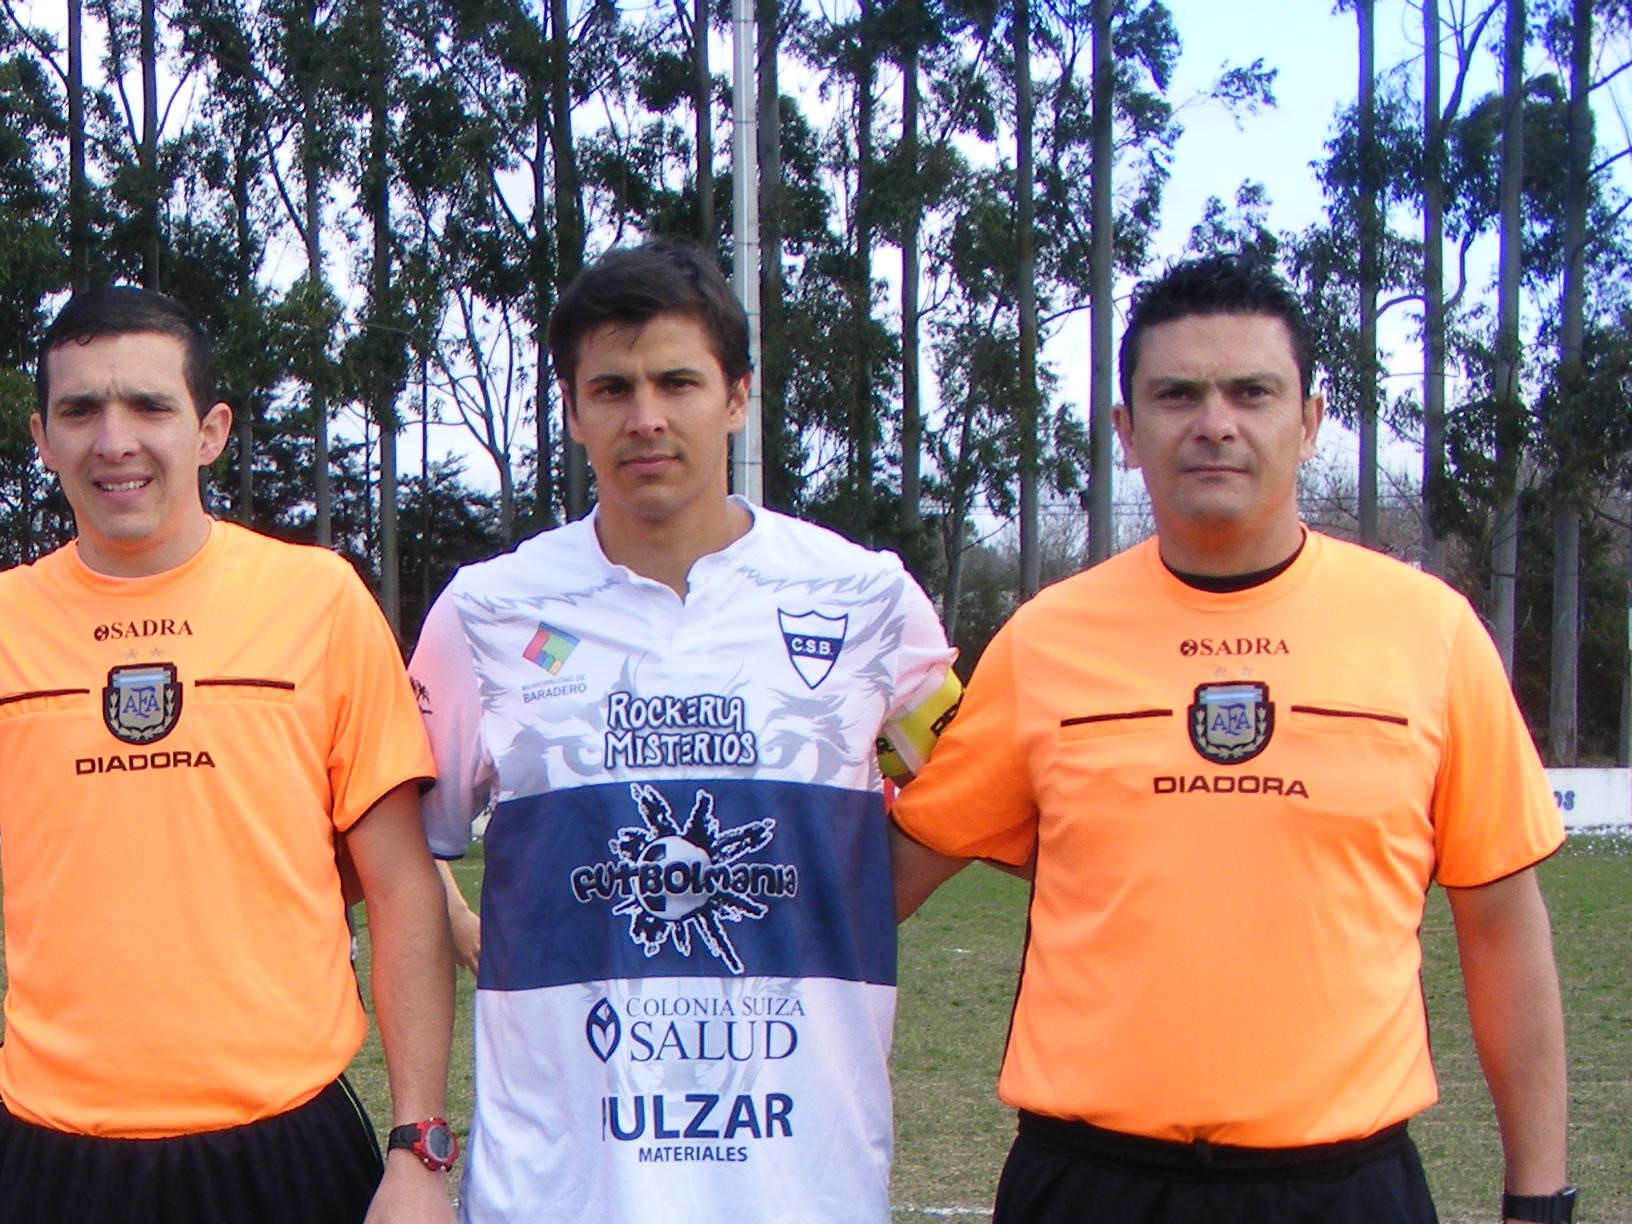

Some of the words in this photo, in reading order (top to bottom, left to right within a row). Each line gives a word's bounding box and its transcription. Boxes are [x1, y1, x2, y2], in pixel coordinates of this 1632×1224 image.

[122, 686, 161, 718] AFA
[522, 683, 587, 704] BARADERO
[1211, 703, 1251, 736] AFA
[75, 751, 216, 775] DIADORA
[604, 731, 758, 769] MISTERIOS
[1153, 775, 1309, 799] DIADORA
[626, 997, 735, 1017] COLONIA
[743, 996, 805, 1017] SUIZA
[630, 1020, 798, 1062] SALUD
[602, 1093, 794, 1142] ULZAR
[639, 1146, 748, 1163] MATERIALES
